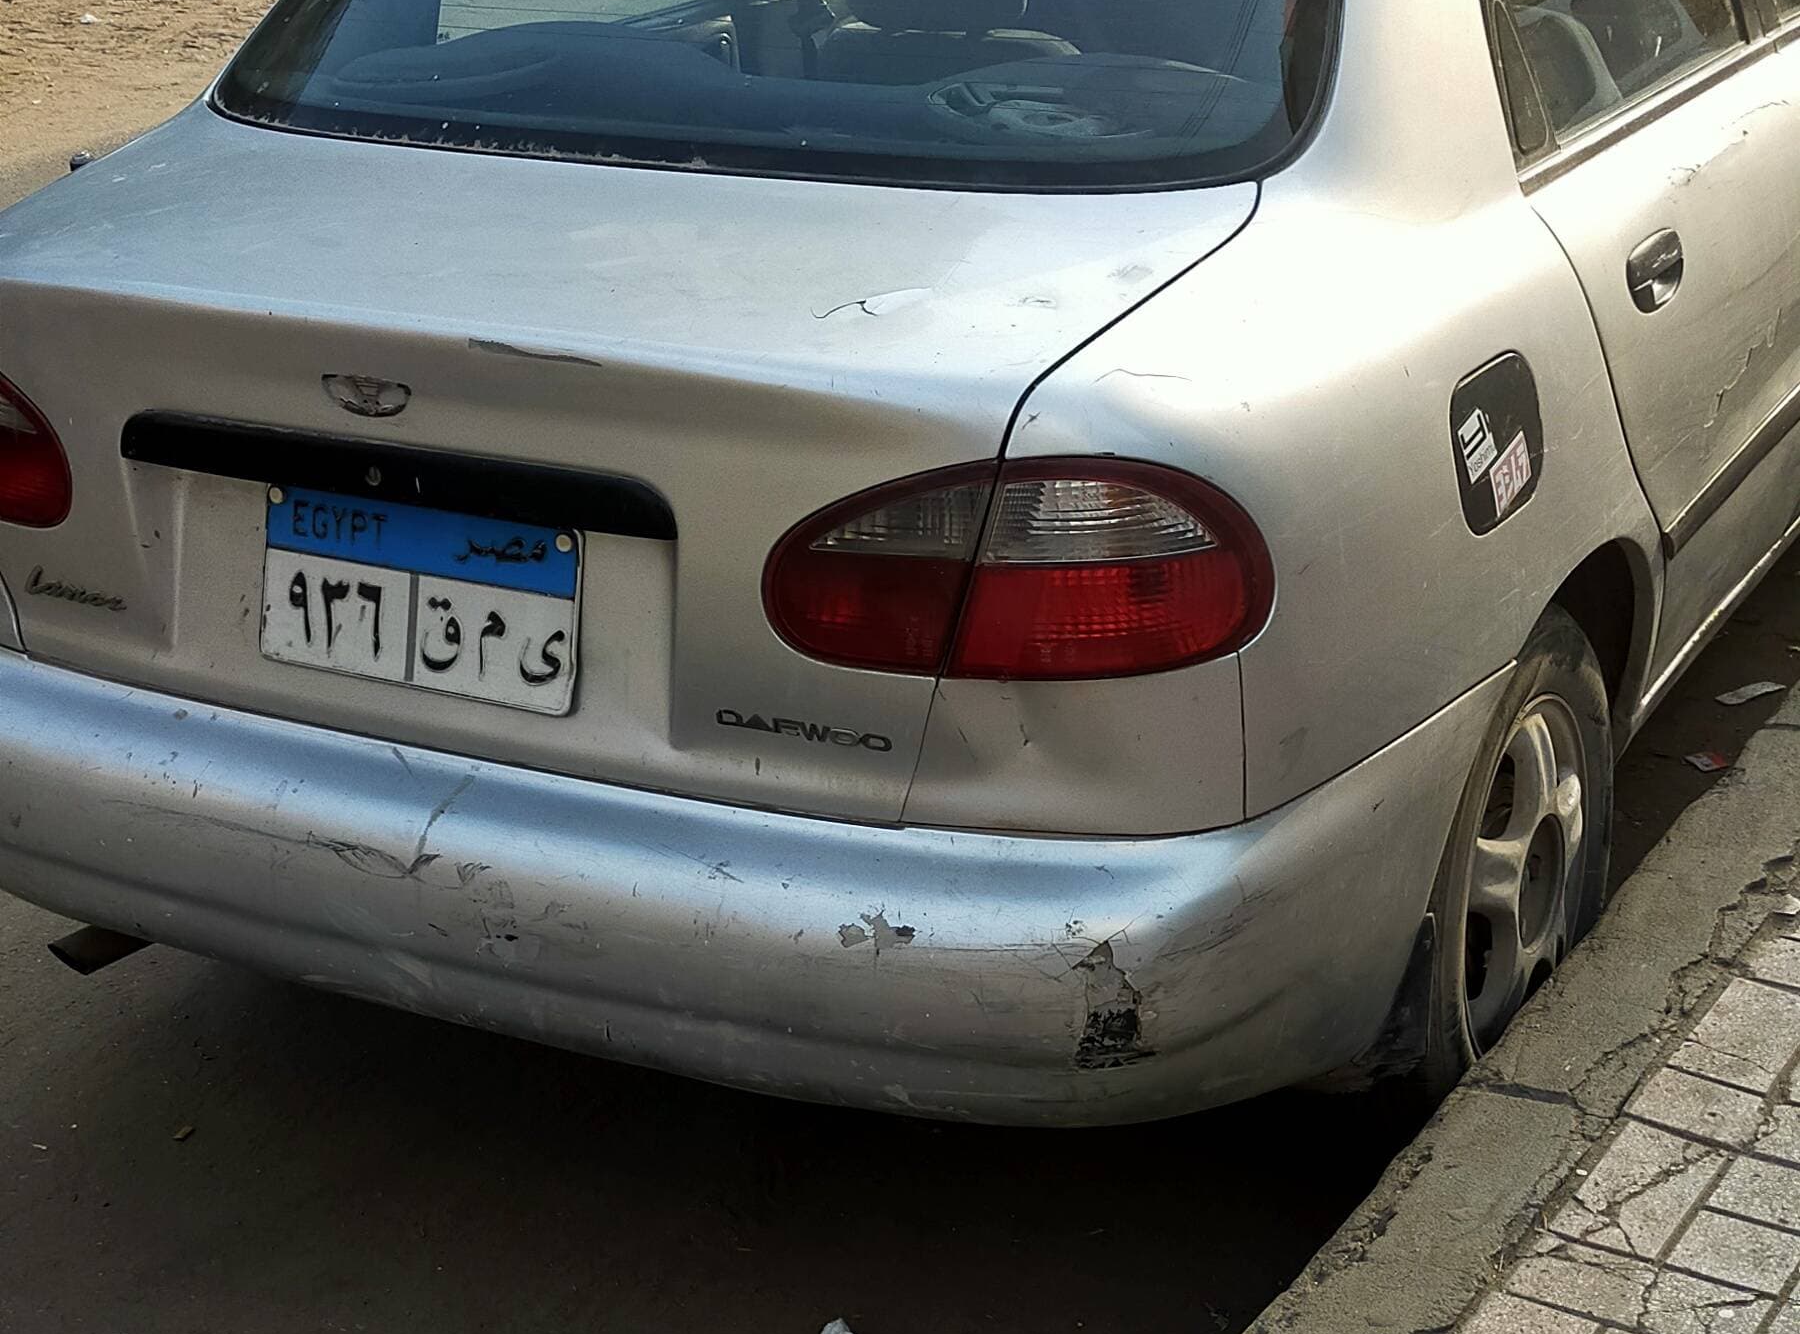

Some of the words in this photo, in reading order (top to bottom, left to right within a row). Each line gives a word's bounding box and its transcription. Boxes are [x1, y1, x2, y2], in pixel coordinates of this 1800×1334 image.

[292, 499, 388, 547] EGYPT
[454, 536, 547, 564] مصر
[289, 571, 384, 662] ٩٣٦
[716, 708, 893, 752] DAEWOO
